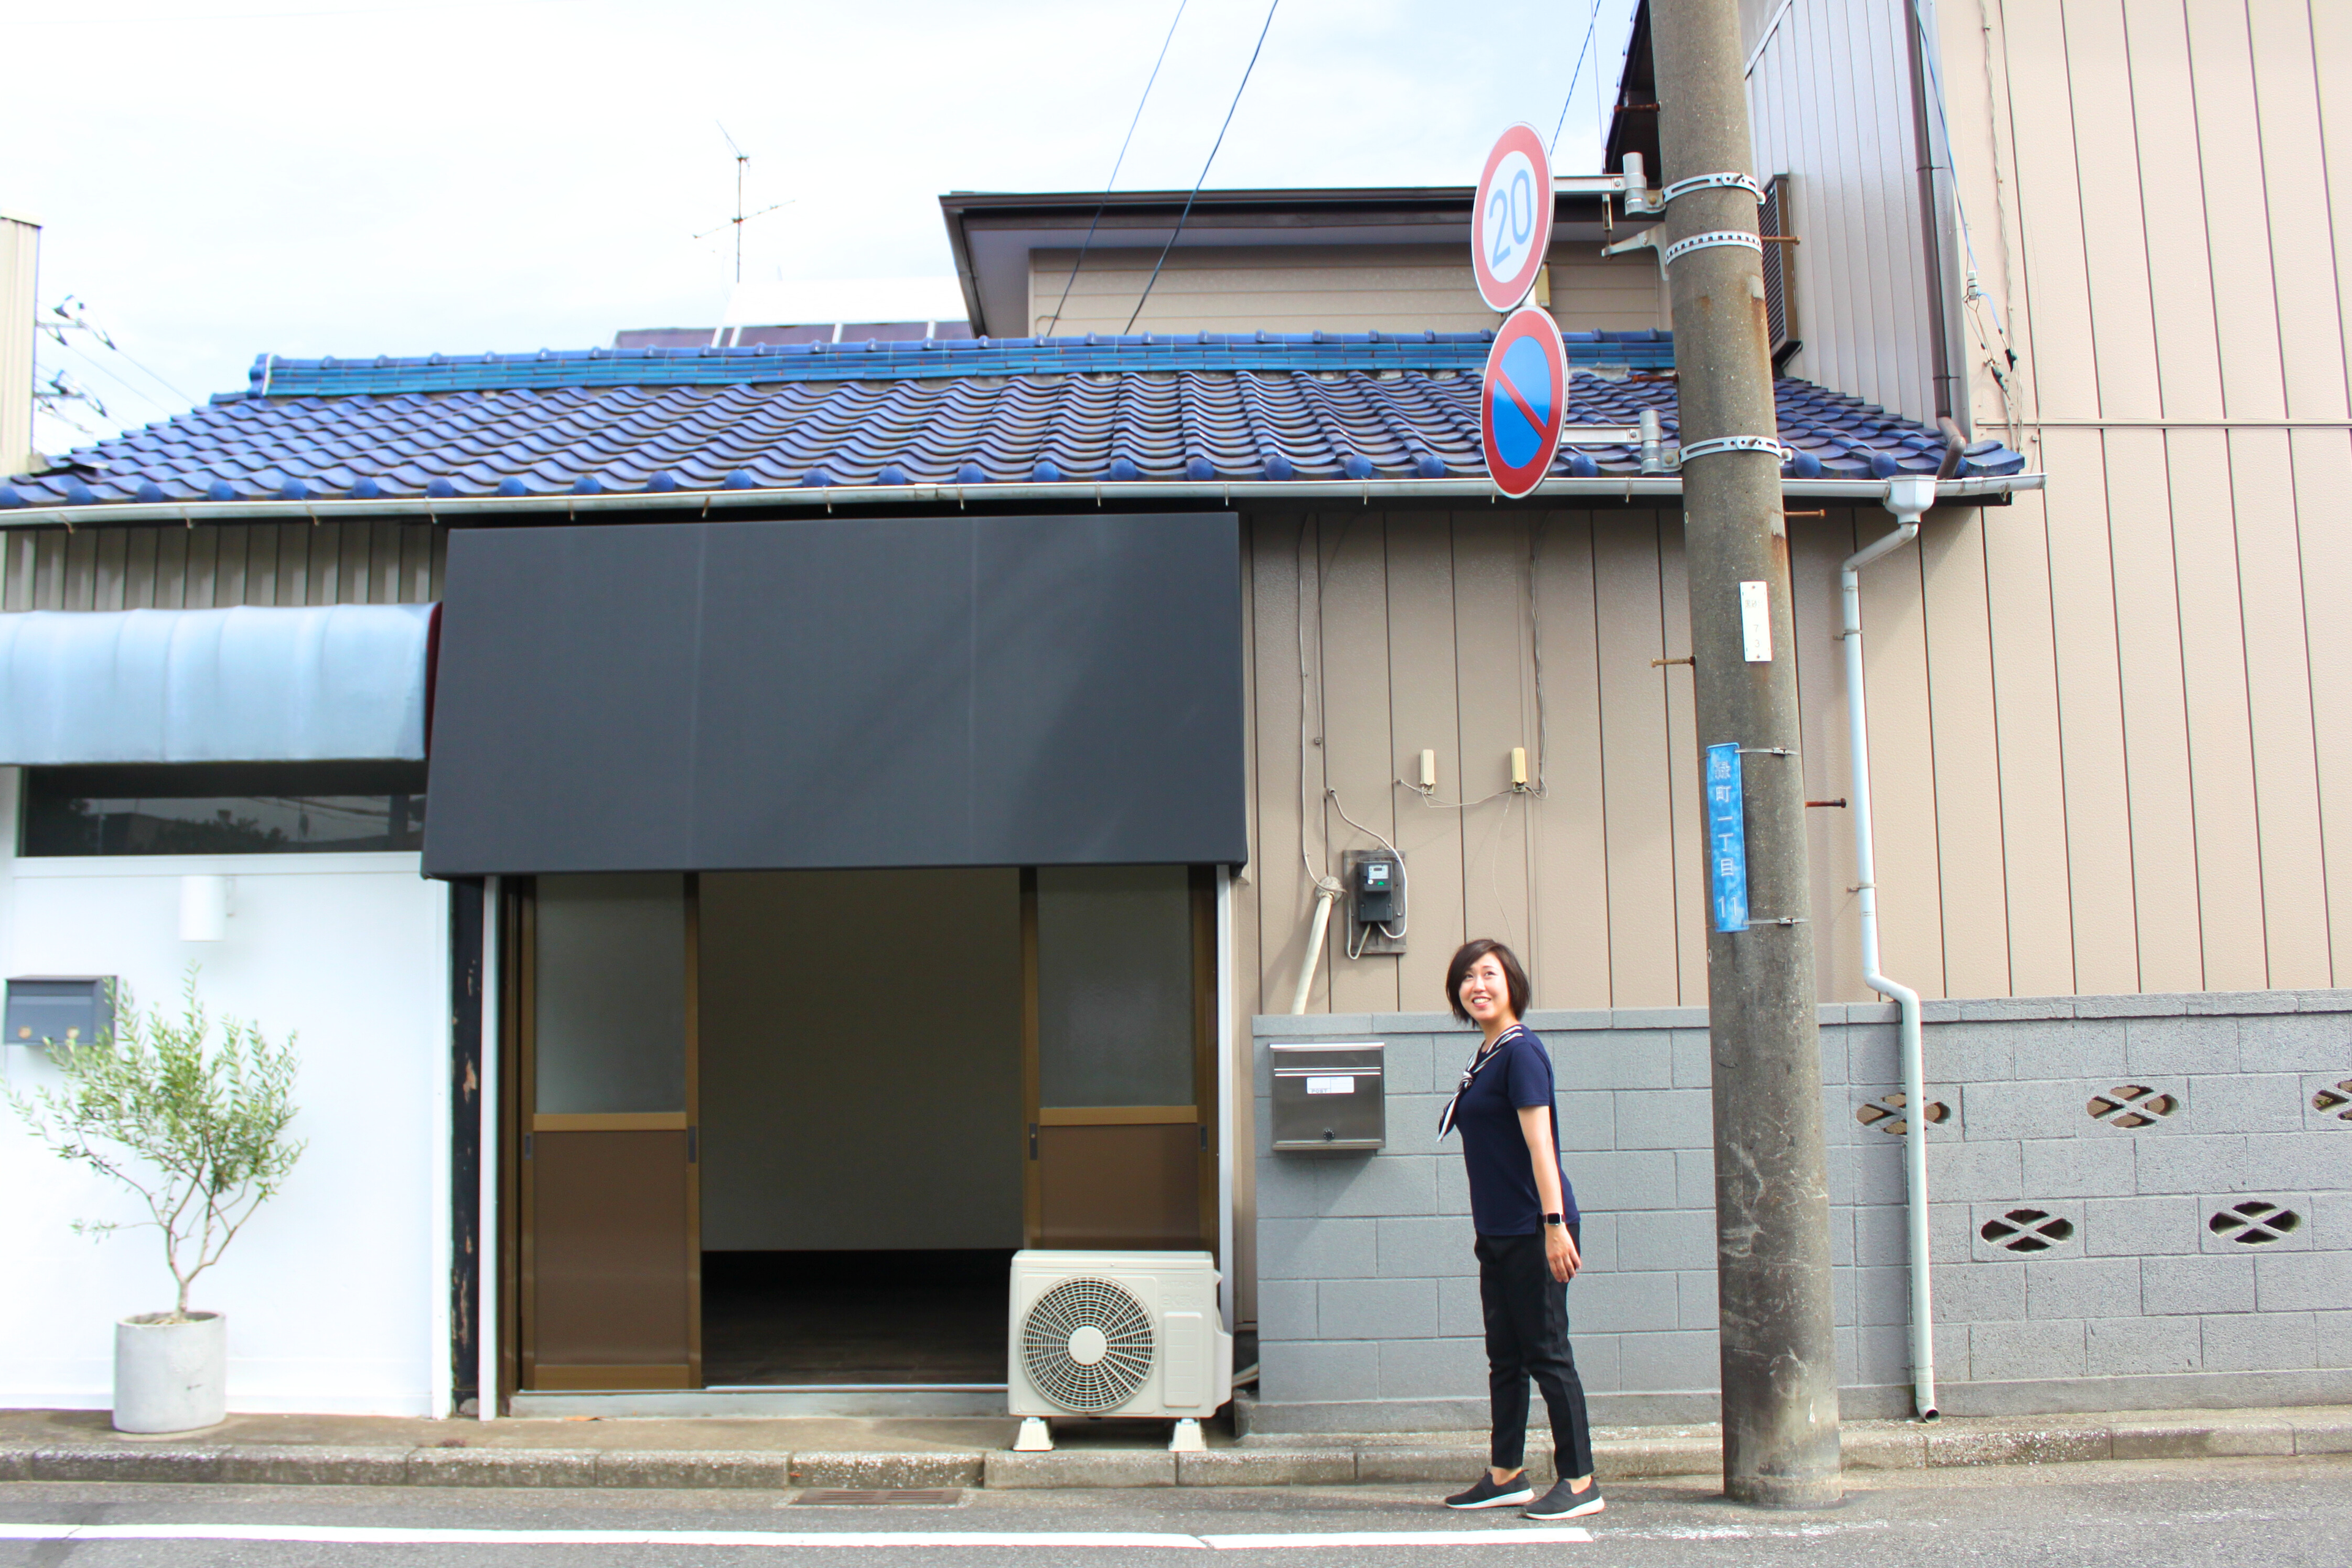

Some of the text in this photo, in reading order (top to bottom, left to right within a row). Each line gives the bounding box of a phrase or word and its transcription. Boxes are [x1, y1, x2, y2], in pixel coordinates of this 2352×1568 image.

[1488, 168, 1531, 270] 20
[1718, 895, 1737, 918] 11
[1160, 1280, 1205, 1289] HITACHI
